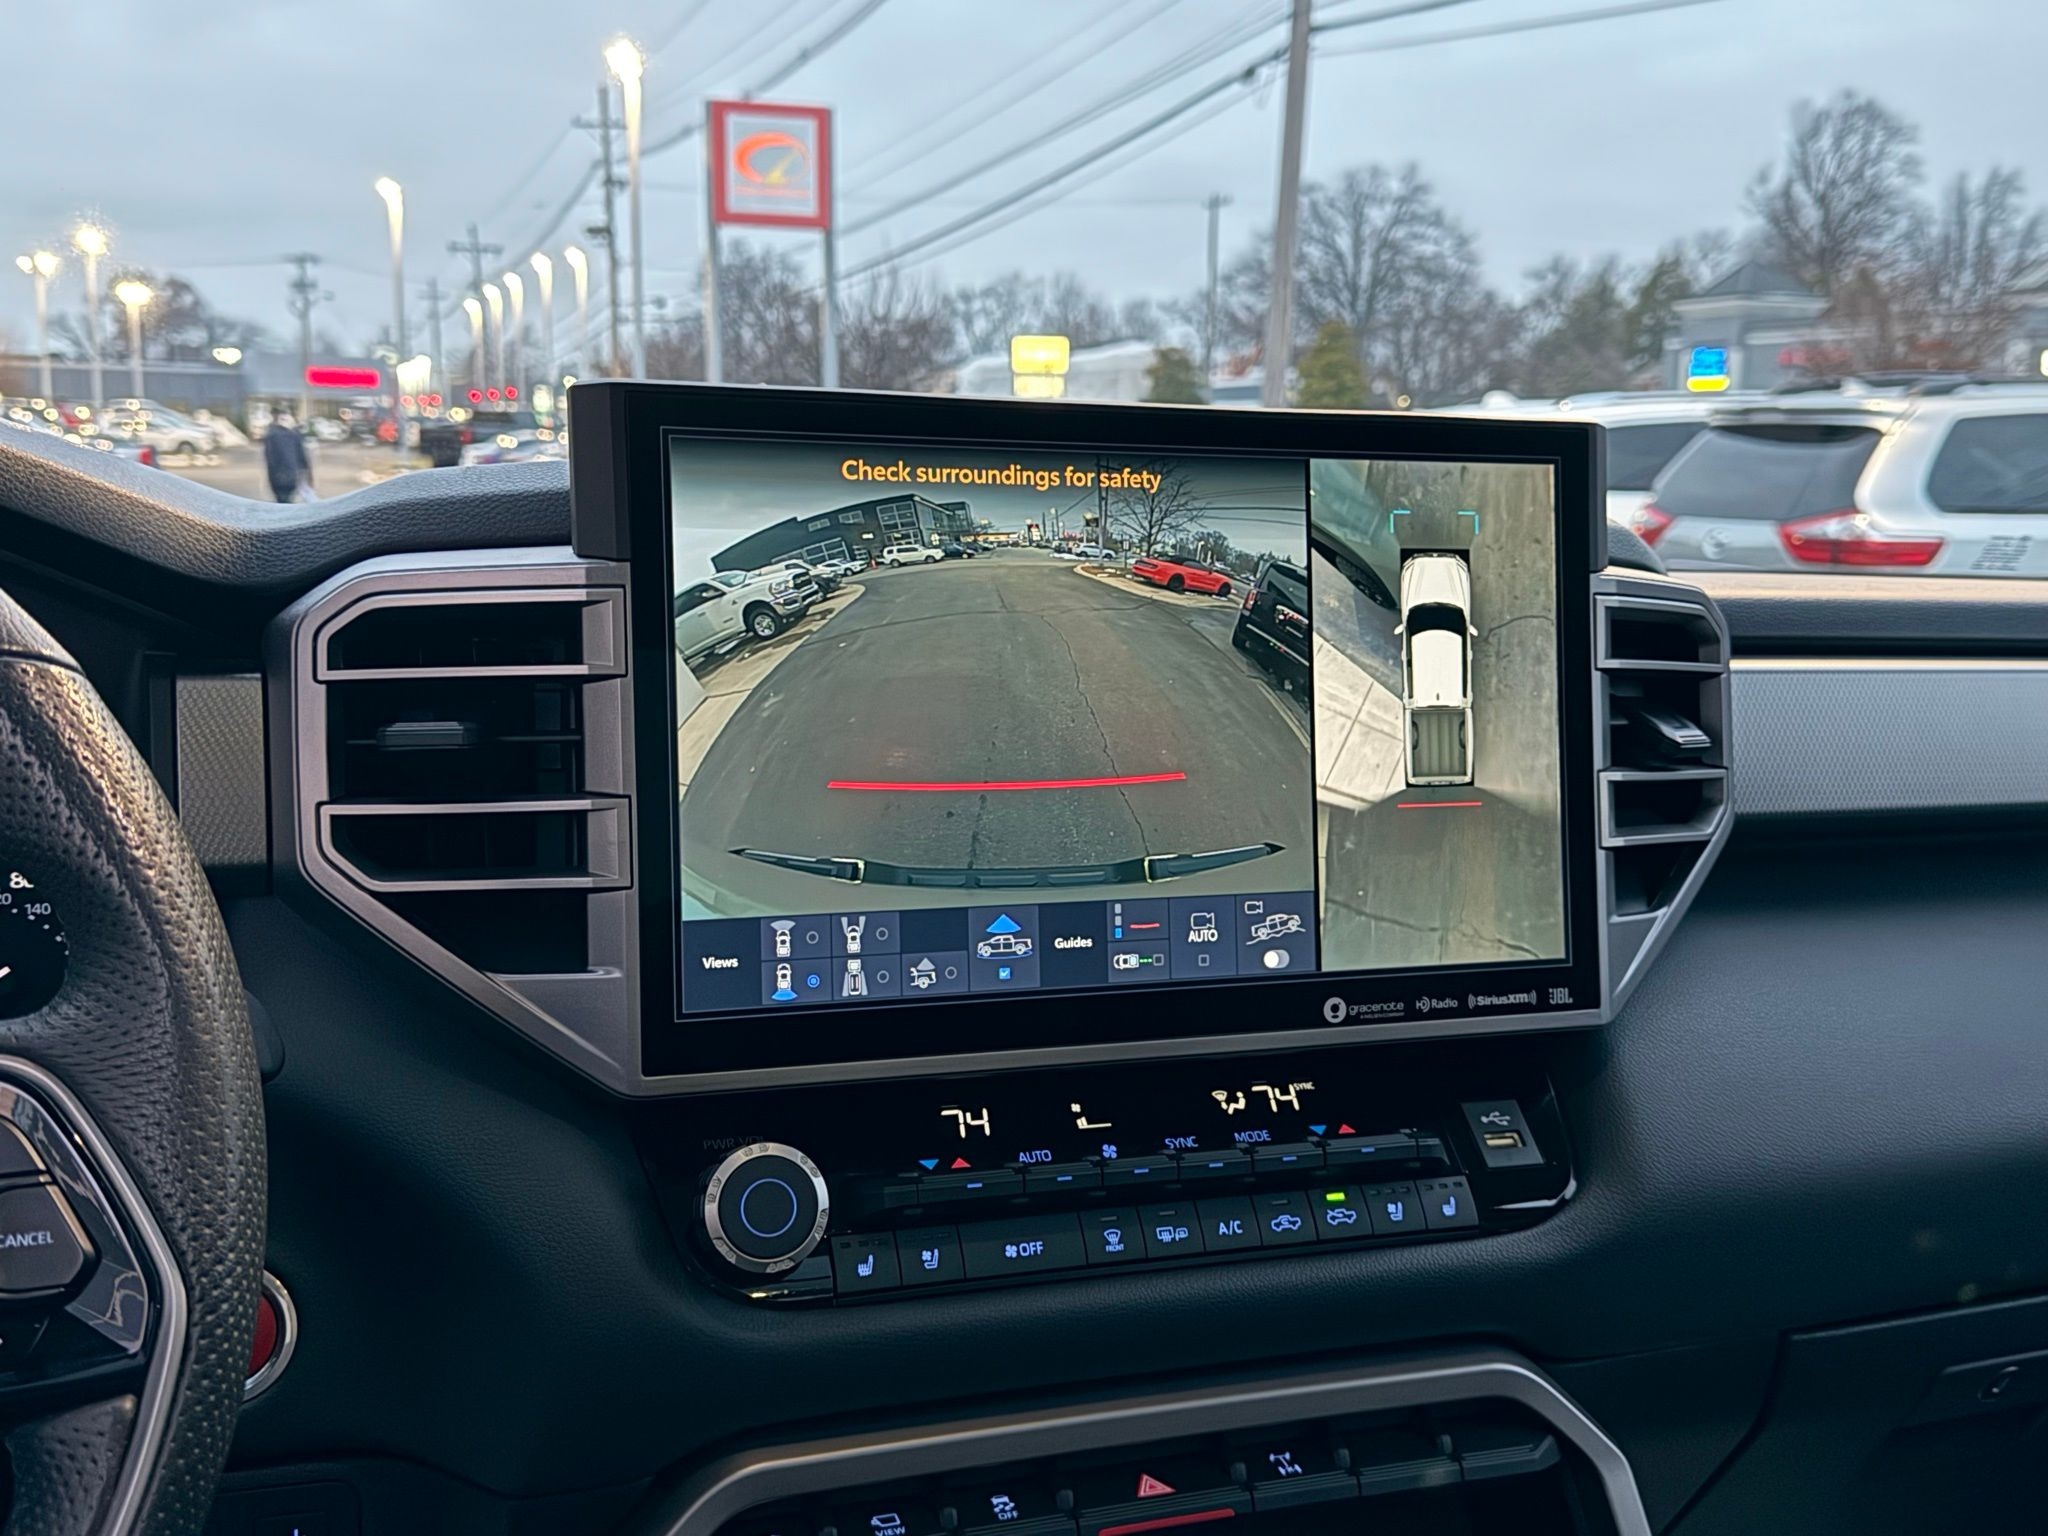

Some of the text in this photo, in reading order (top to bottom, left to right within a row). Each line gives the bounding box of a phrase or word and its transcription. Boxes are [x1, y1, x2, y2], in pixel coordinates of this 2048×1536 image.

[840, 459, 1162, 493] Check surroundings for safety
[24, 902, 52, 915] 140
[1054, 936, 1093, 949] Guides
[1187, 929, 1219, 943] AUTO
[702, 956, 739, 970] Views
[1549, 987, 1573, 1004] JBL
[1348, 1001, 1405, 1016] gracenote
[1431, 998, 1458, 1009] Radio
[1251, 1083, 1300, 1113] 74
[941, 1107, 991, 1139] 74
[1164, 1136, 1199, 1149] SYNC
[1233, 1129, 1272, 1143] MODE
[1018, 1149, 1053, 1163] AUTO
[1218, 1220, 1244, 1235] A/C
[1019, 1241, 1044, 1257] OFF
[1105, 1243, 1124, 1252] FRONT
[998, 1510, 1019, 1520] OFF
[874, 1526, 906, 1536] VIEW
